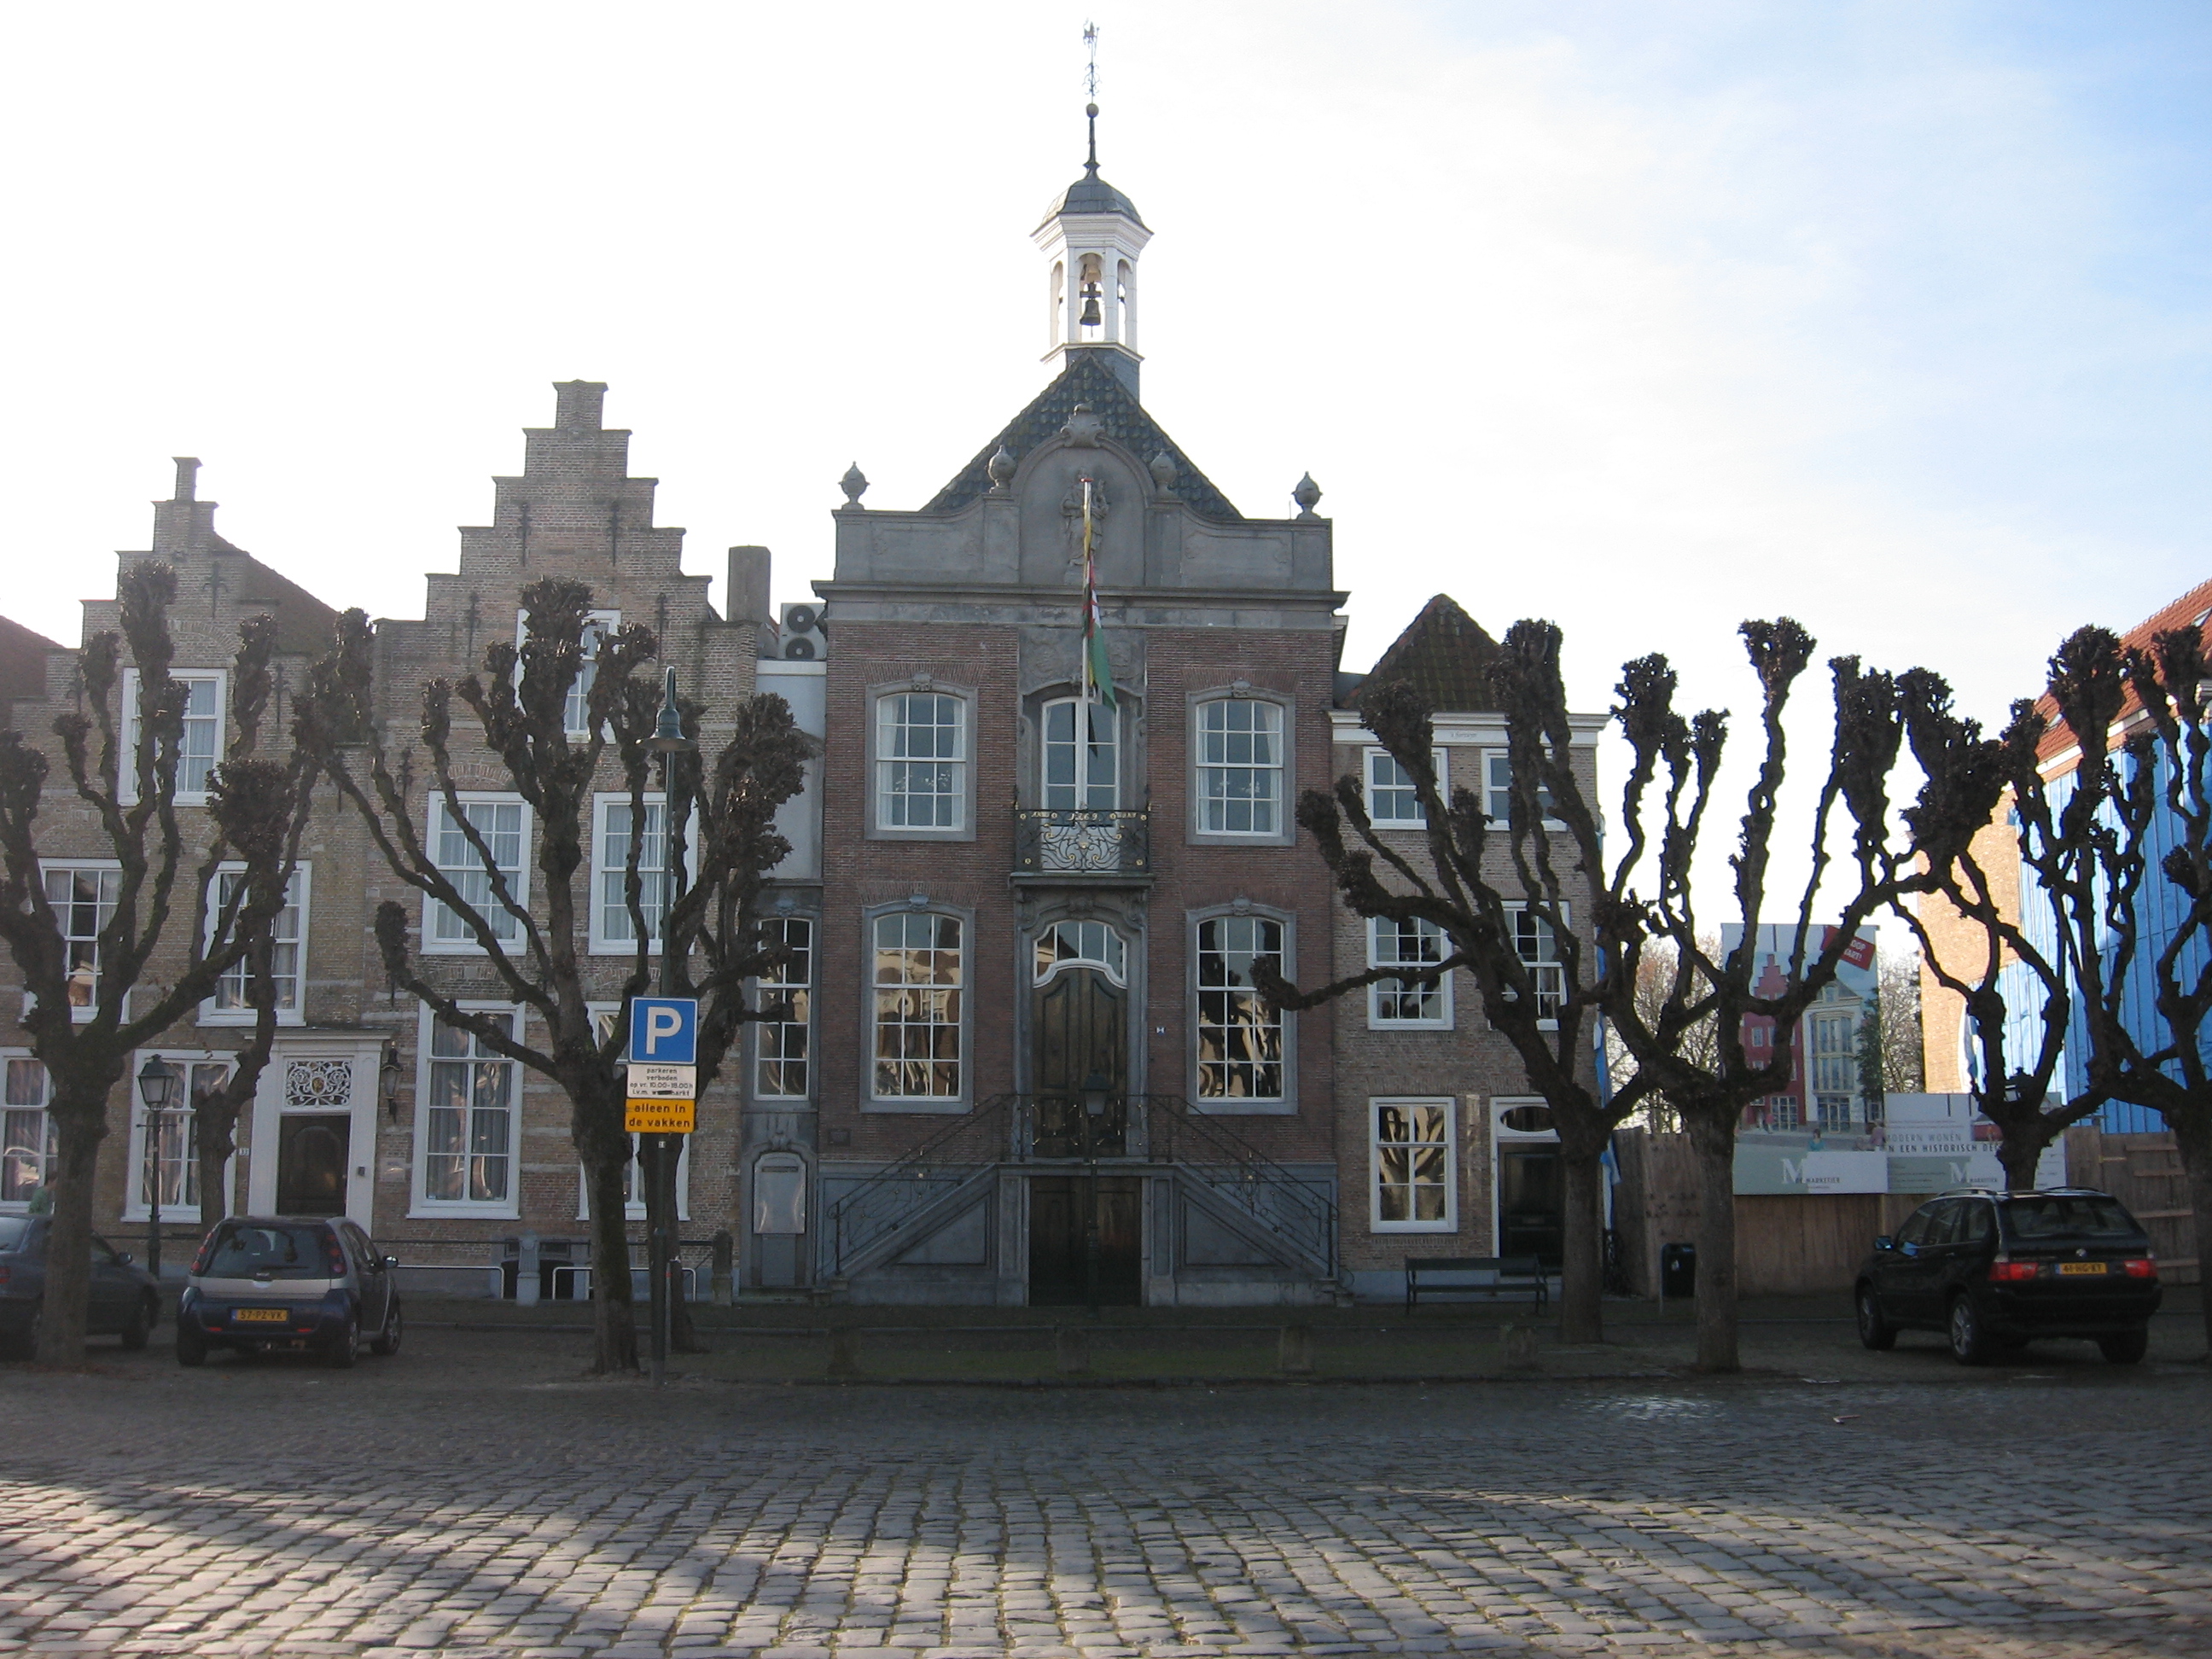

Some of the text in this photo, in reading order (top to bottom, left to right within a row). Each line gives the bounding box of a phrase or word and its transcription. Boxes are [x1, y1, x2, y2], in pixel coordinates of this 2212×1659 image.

[646, 1006, 683, 1055] P
[634, 1103, 686, 1113] alleen in
[629, 1117, 690, 1127] de vakken
[1900, 1144, 1917, 1153] EEN
[1922, 1144, 1977, 1153] HISTORISCH
